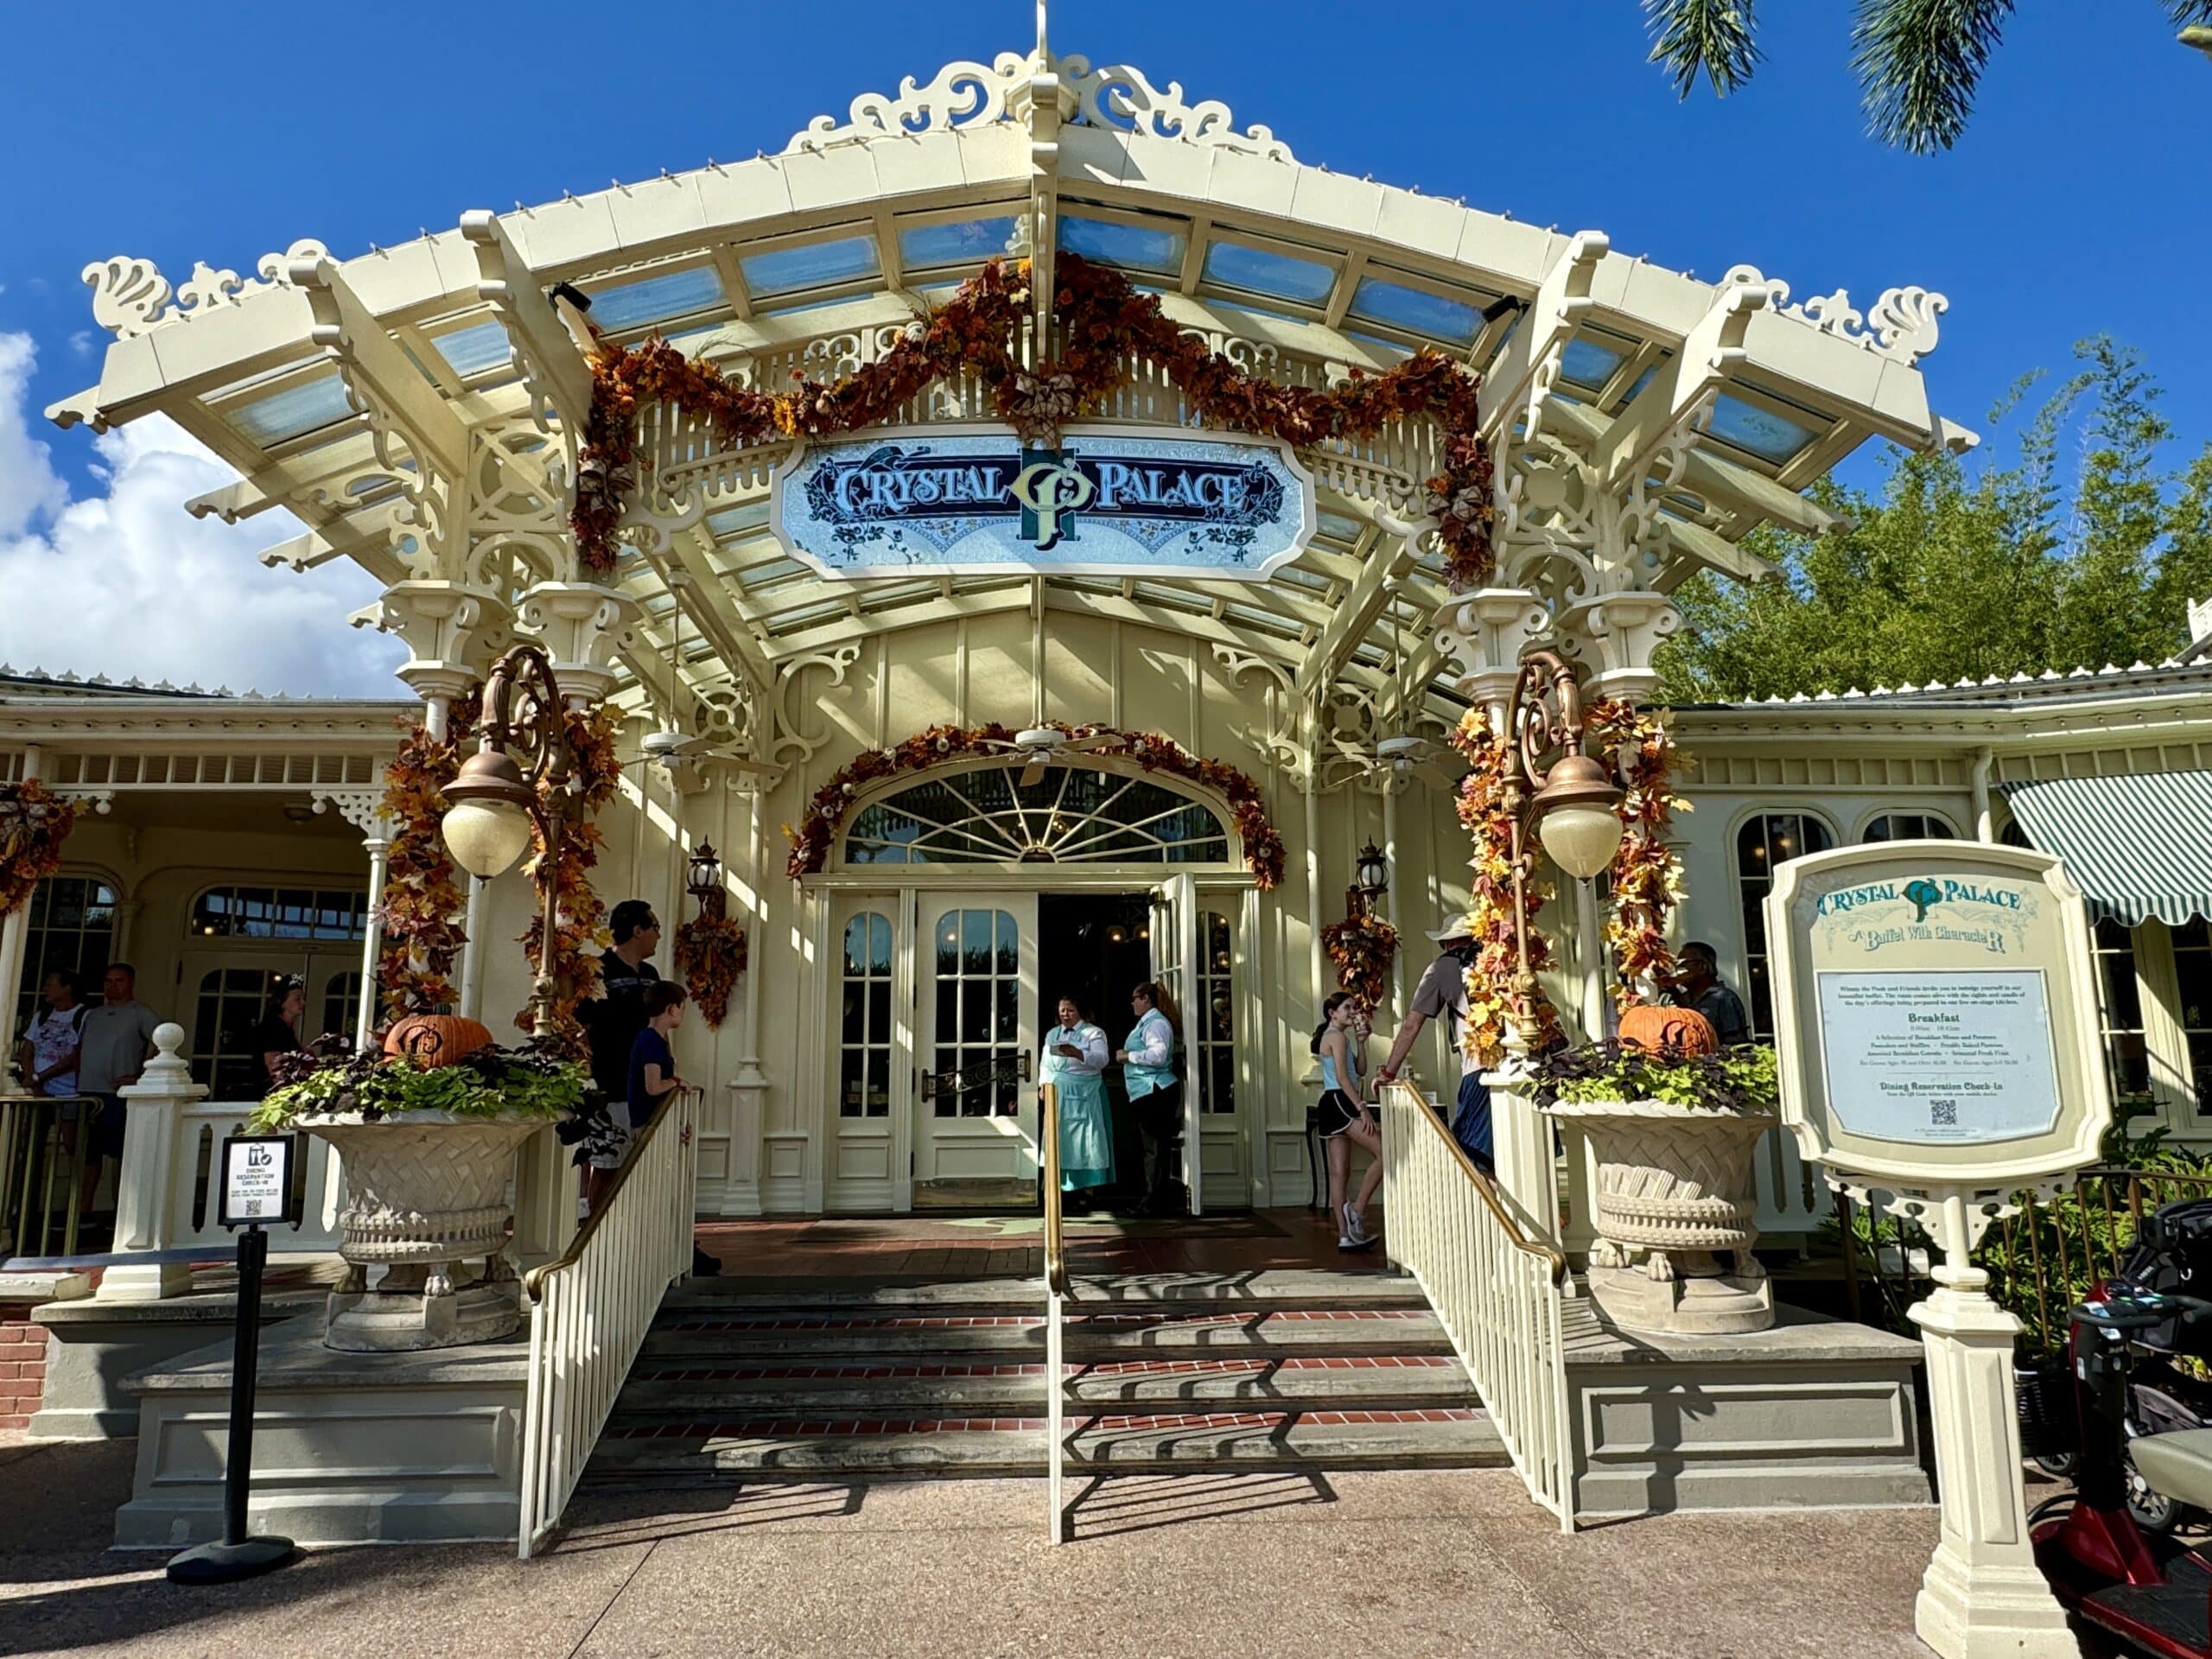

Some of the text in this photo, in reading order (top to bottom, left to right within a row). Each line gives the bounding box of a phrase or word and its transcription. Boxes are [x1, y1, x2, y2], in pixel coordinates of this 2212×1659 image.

[836, 461, 1249, 515] CRYSTAL PALACE
[1817, 879, 2021, 916] CRYSTAL PALACE
[1864, 926, 1904, 951] Buffet
[1907, 925, 1932, 941] With
[1908, 1013, 1961, 1023] Breakfast
[1879, 1082, 2004, 1092] Dining Reservation Check-In
